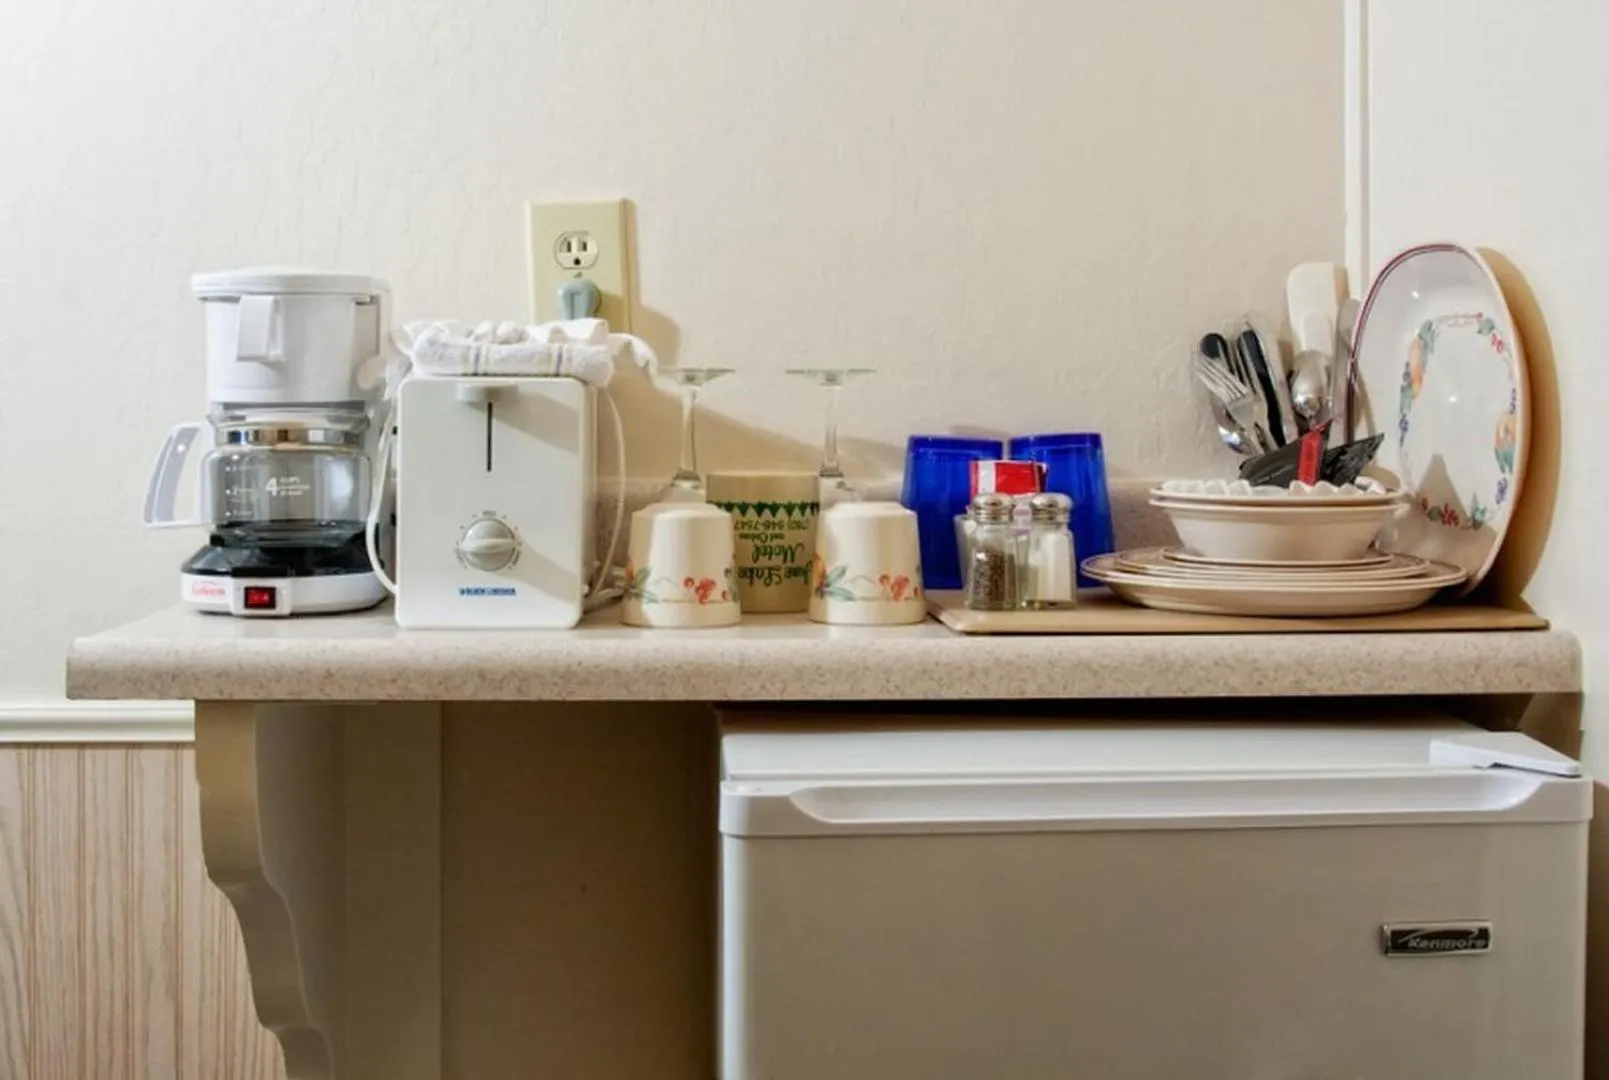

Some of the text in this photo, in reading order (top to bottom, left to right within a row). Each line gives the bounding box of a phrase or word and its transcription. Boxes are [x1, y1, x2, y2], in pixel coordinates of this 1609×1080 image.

[265, 476, 277, 496] 4
[752, 543, 804, 564] Motel
[738, 566, 782, 589] Lake
[1408, 937, 1486, 950] Kenmore
